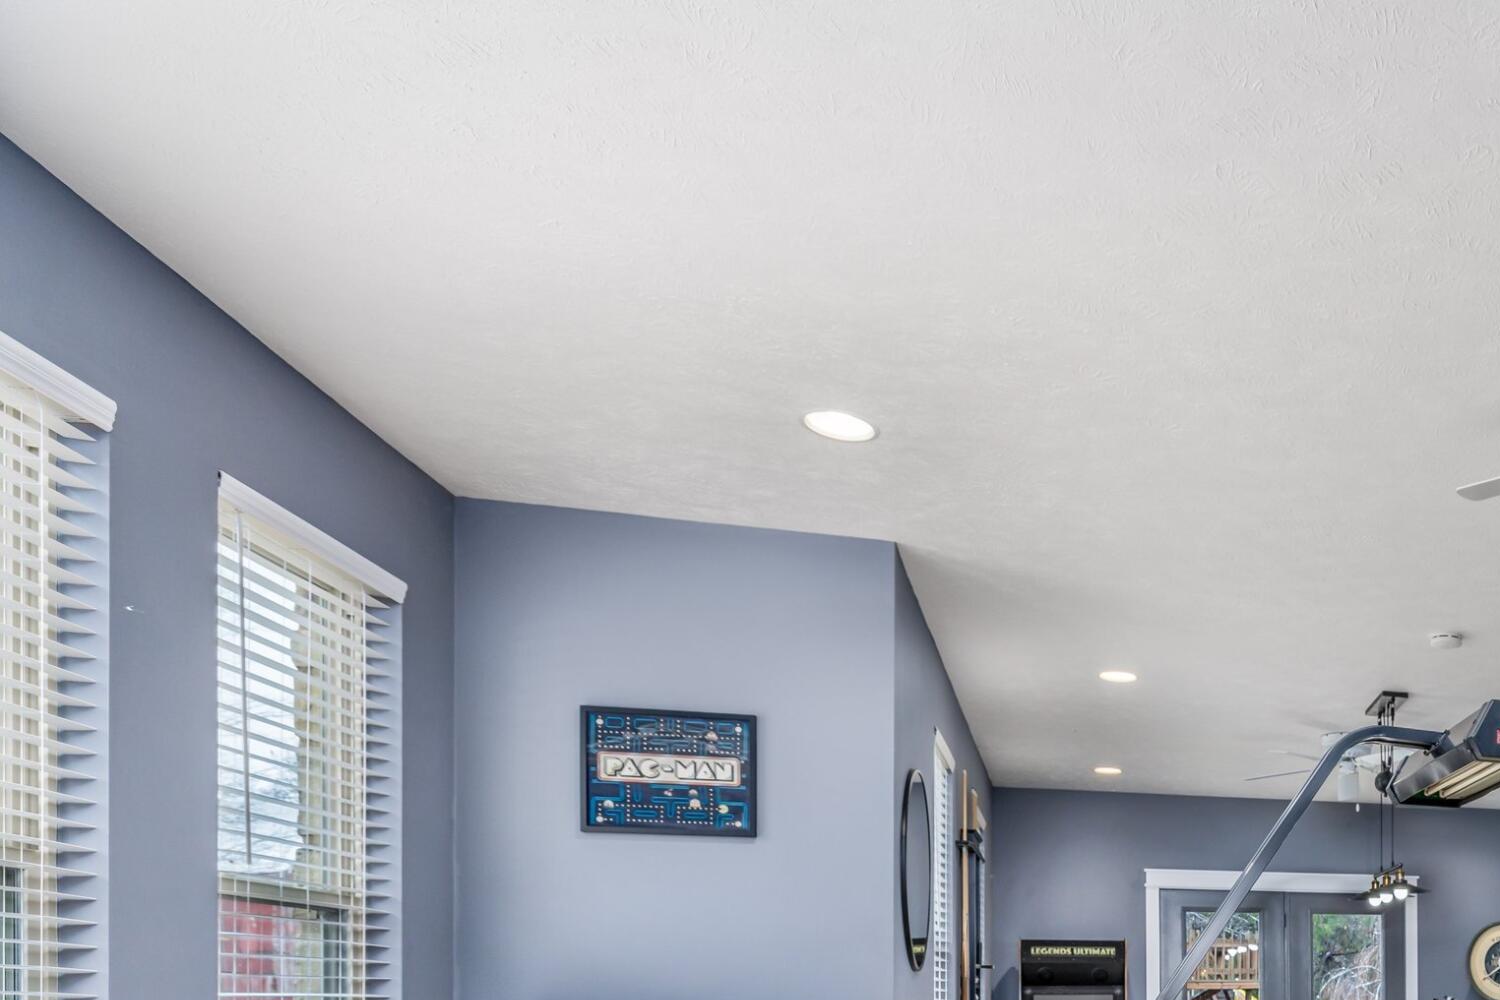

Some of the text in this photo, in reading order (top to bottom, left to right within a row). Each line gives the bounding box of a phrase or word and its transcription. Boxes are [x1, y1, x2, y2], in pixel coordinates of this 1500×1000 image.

[604, 757, 735, 782] PAC-MAN
[1030, 945, 1116, 956] LEGENDS ULTIMATE
